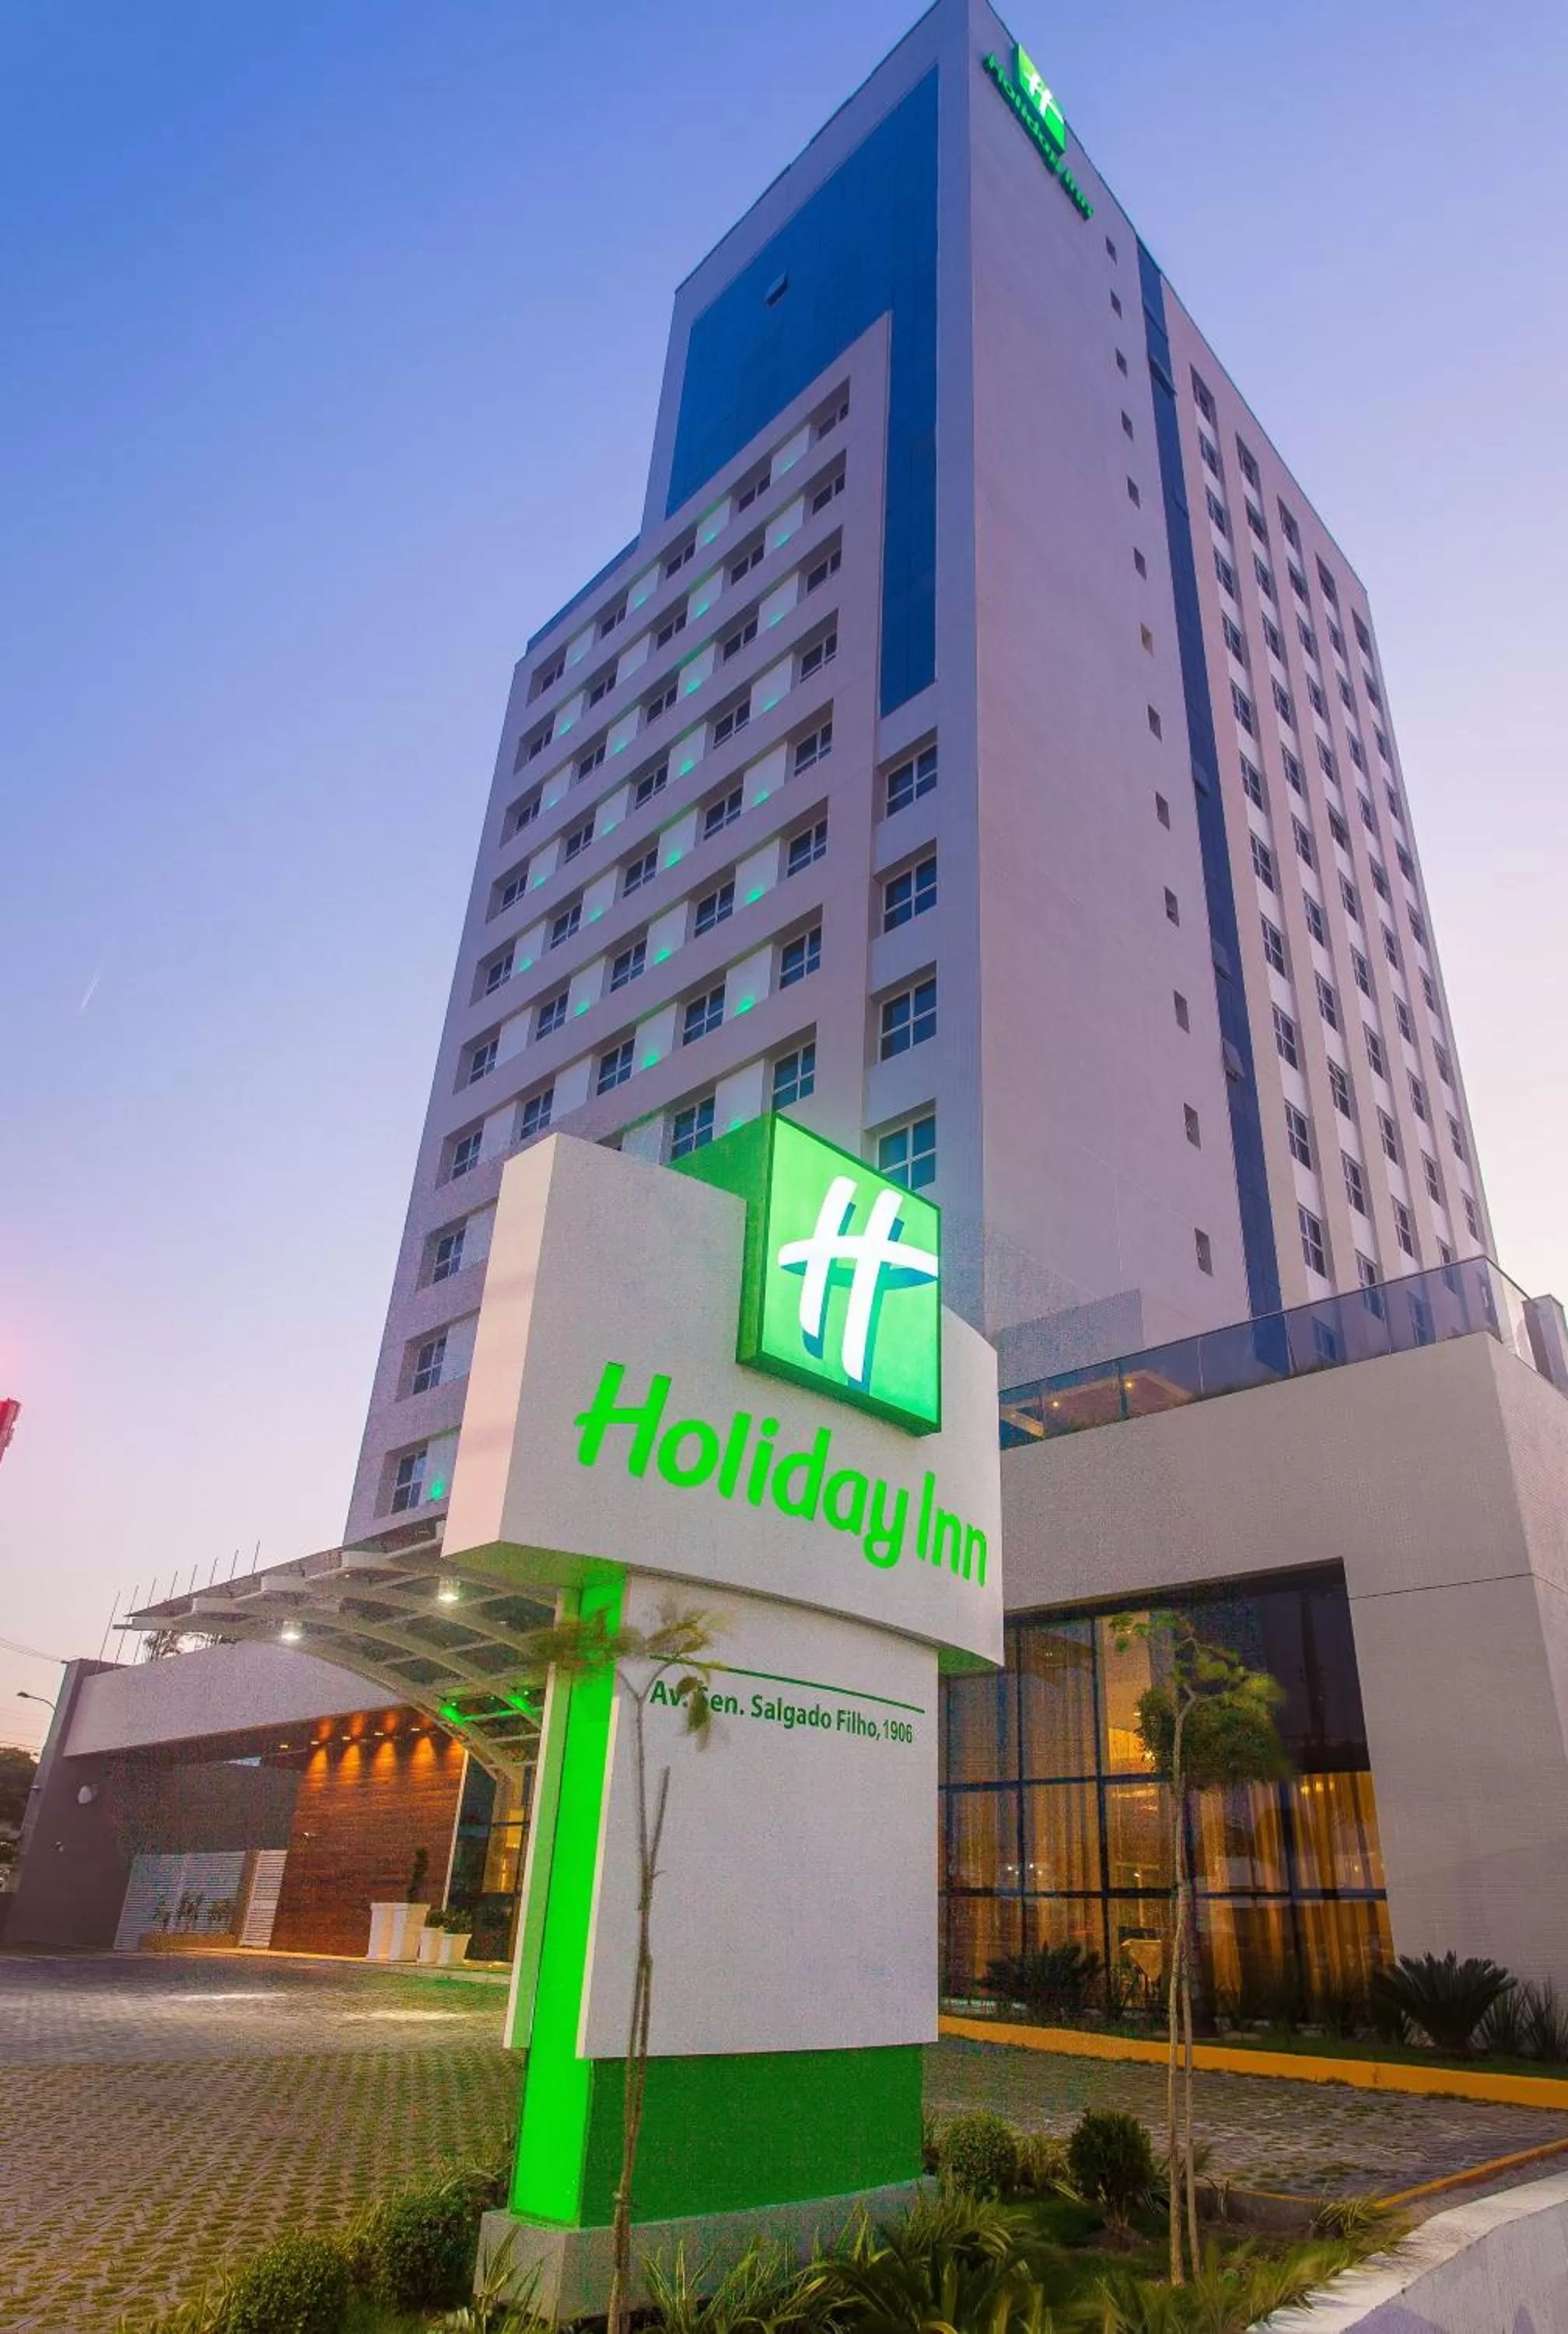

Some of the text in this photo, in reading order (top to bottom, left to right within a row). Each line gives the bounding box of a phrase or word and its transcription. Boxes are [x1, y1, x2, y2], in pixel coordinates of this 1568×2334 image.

[574, 1362, 987, 1587] Holiday Inn
[649, 1680, 913, 1743] Av. en. Salgado Filho, 1906
